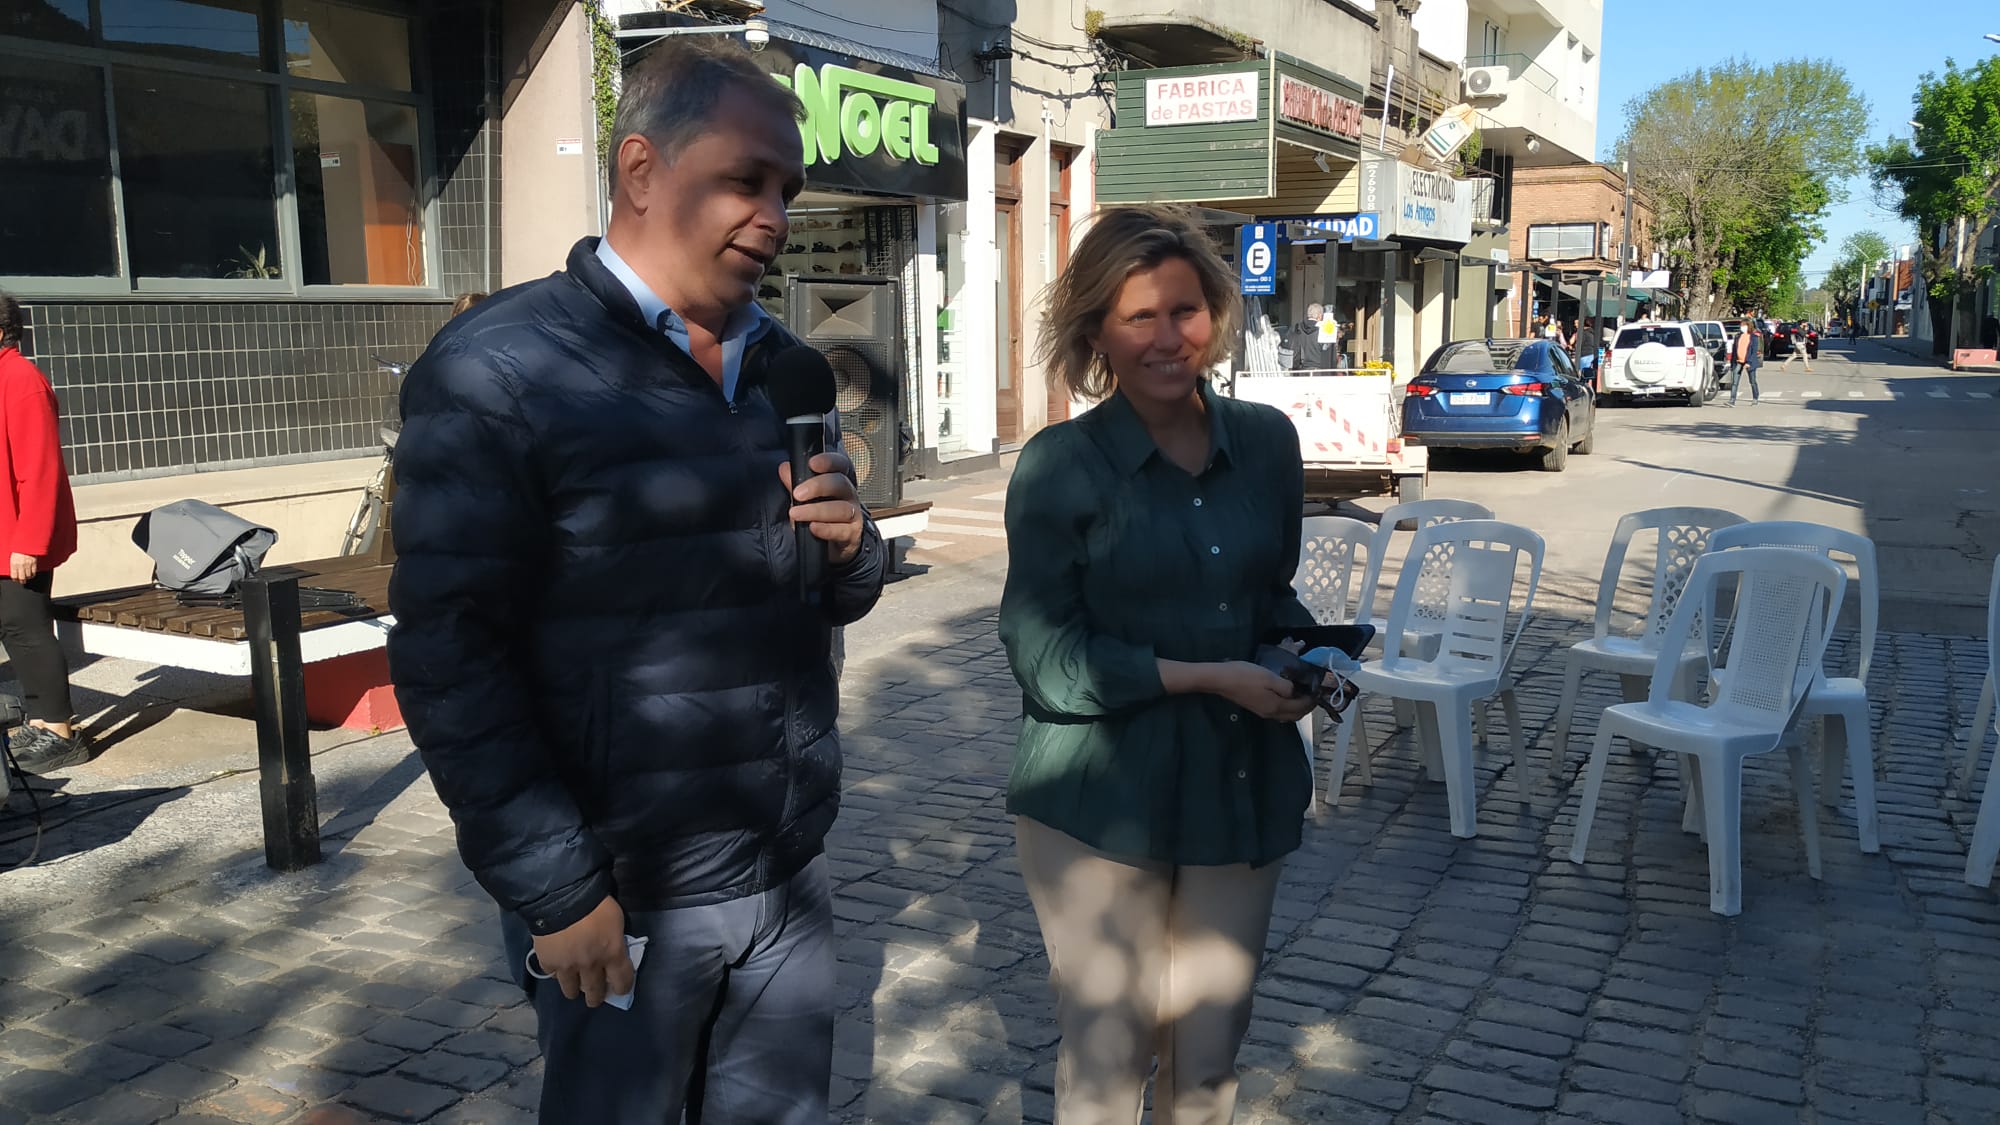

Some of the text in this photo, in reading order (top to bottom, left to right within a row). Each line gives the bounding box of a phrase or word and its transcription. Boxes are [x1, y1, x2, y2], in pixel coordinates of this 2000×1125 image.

[1158, 78, 1245, 99] FABRICA
[1151, 99, 1253, 121] de PASTAS
[1412, 170, 1456, 204] ELECTRICIDAD
[1403, 196, 1436, 227] Los Amigos
[1252, 248, 1265, 269] E
